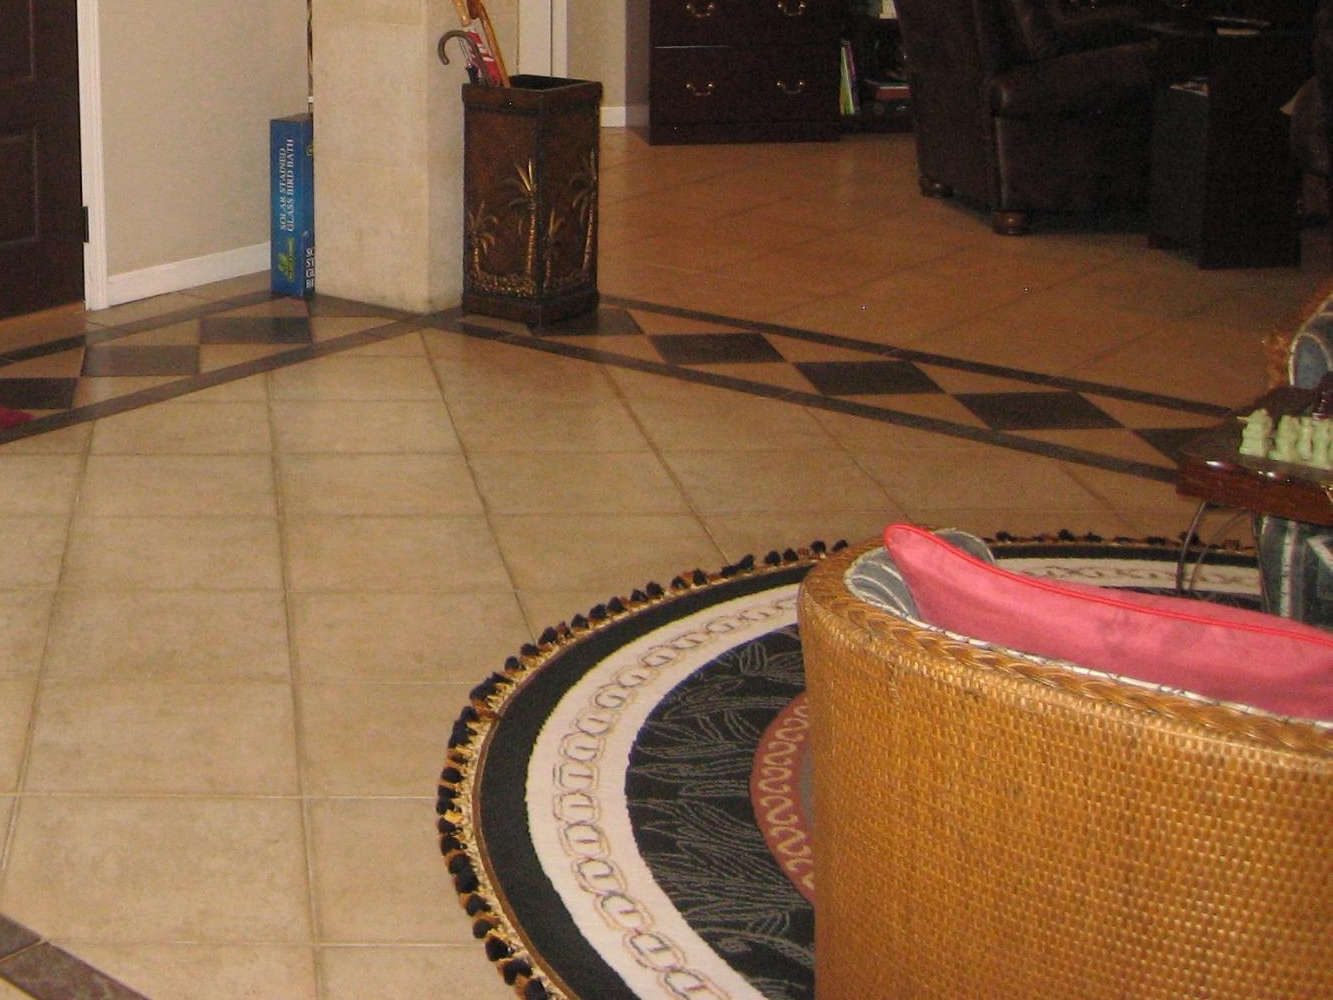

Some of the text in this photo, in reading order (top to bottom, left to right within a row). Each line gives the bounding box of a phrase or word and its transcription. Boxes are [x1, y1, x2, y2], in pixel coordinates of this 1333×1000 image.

[286, 138, 295, 168] BATH
[279, 148, 287, 231] SOLAR STAINED
[286, 170, 295, 196] BIRD
[286, 198, 295, 232] GLASS
